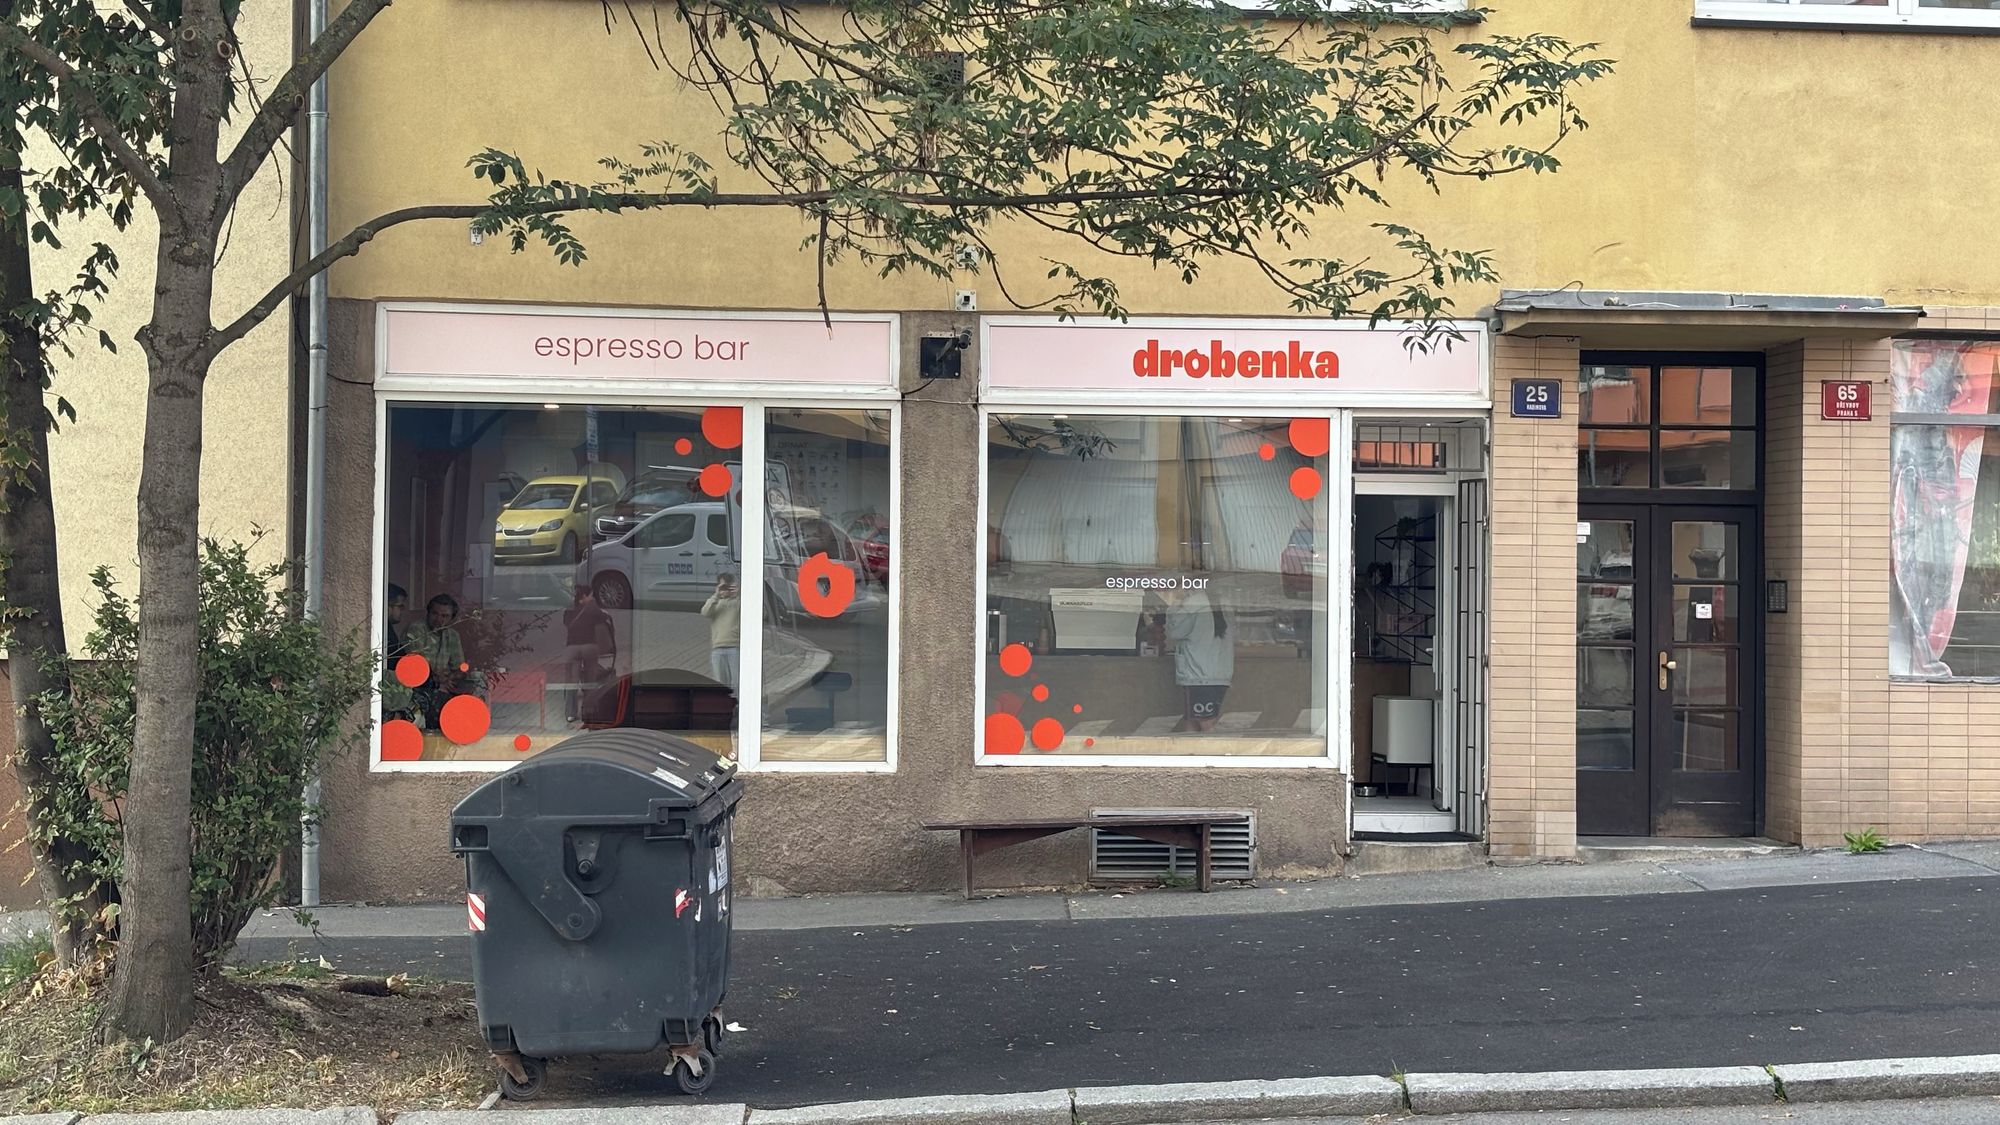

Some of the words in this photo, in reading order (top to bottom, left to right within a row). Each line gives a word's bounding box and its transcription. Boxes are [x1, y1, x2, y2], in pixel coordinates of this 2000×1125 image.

[535, 337, 683, 365] espresso
[695, 334, 750, 361] bar
[1133, 340, 1339, 378] drobenka
[1526, 385, 1548, 402] 25
[1838, 385, 1857, 401] 65
[1106, 577, 1177, 592] espresso
[1182, 575, 1209, 589] bar
